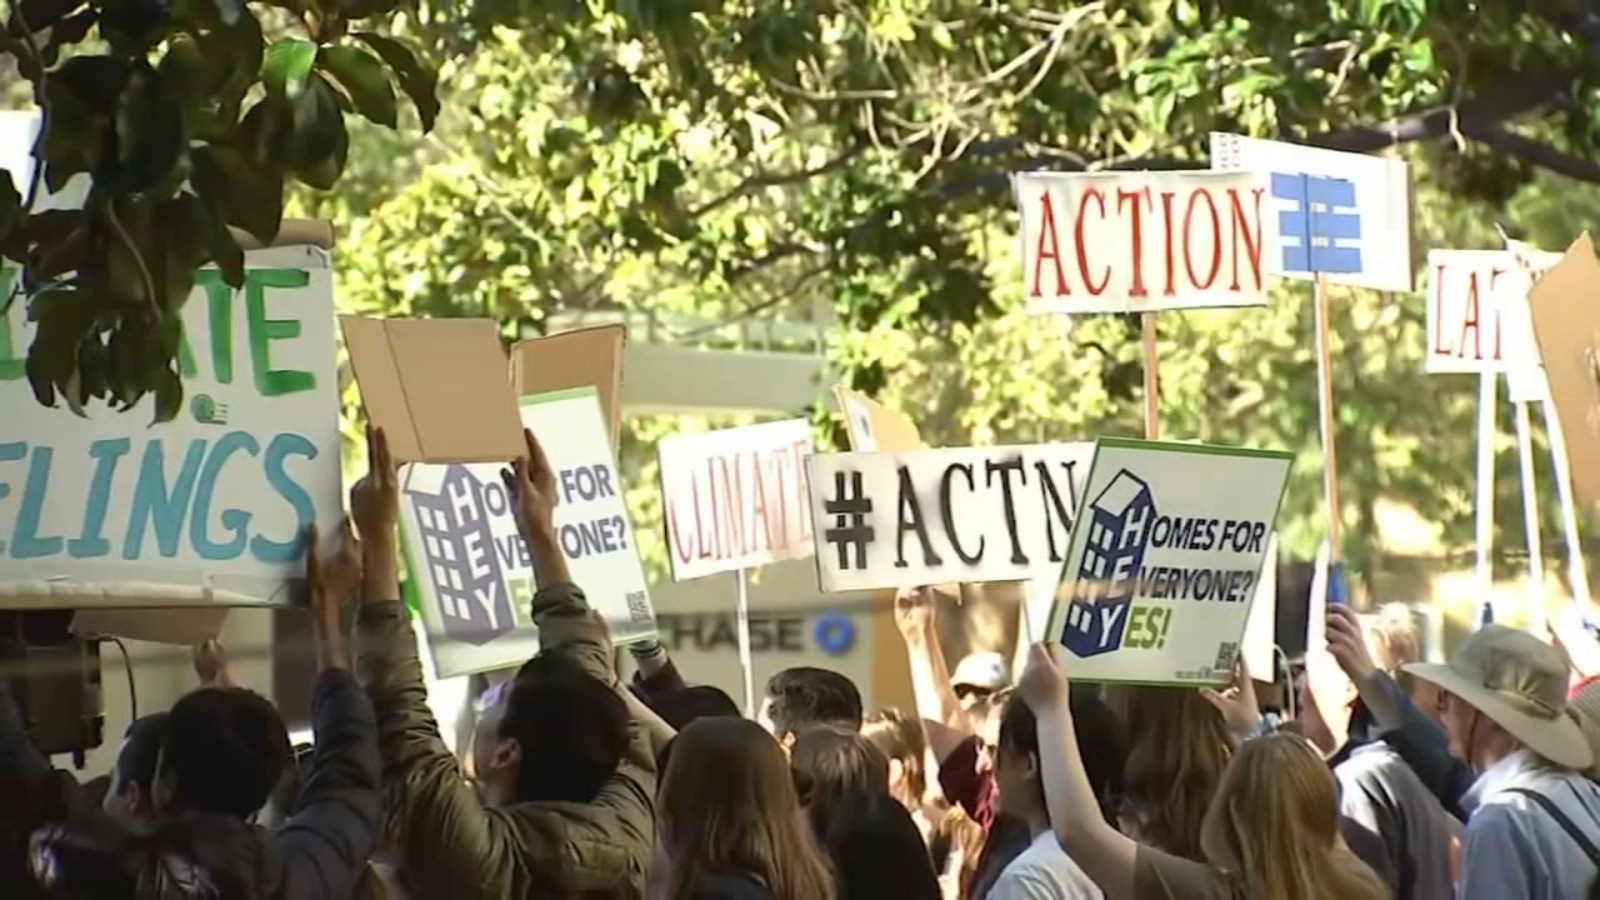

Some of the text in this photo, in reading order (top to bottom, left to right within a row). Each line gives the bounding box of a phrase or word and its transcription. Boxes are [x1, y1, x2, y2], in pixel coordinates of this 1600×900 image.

[1030, 185, 1266, 297] ACTION
[560, 464, 615, 503] FOR
[670, 439, 812, 564] CLIMATE
[1219, 521, 1266, 553] FOR
[1098, 505, 1150, 648] HEY
